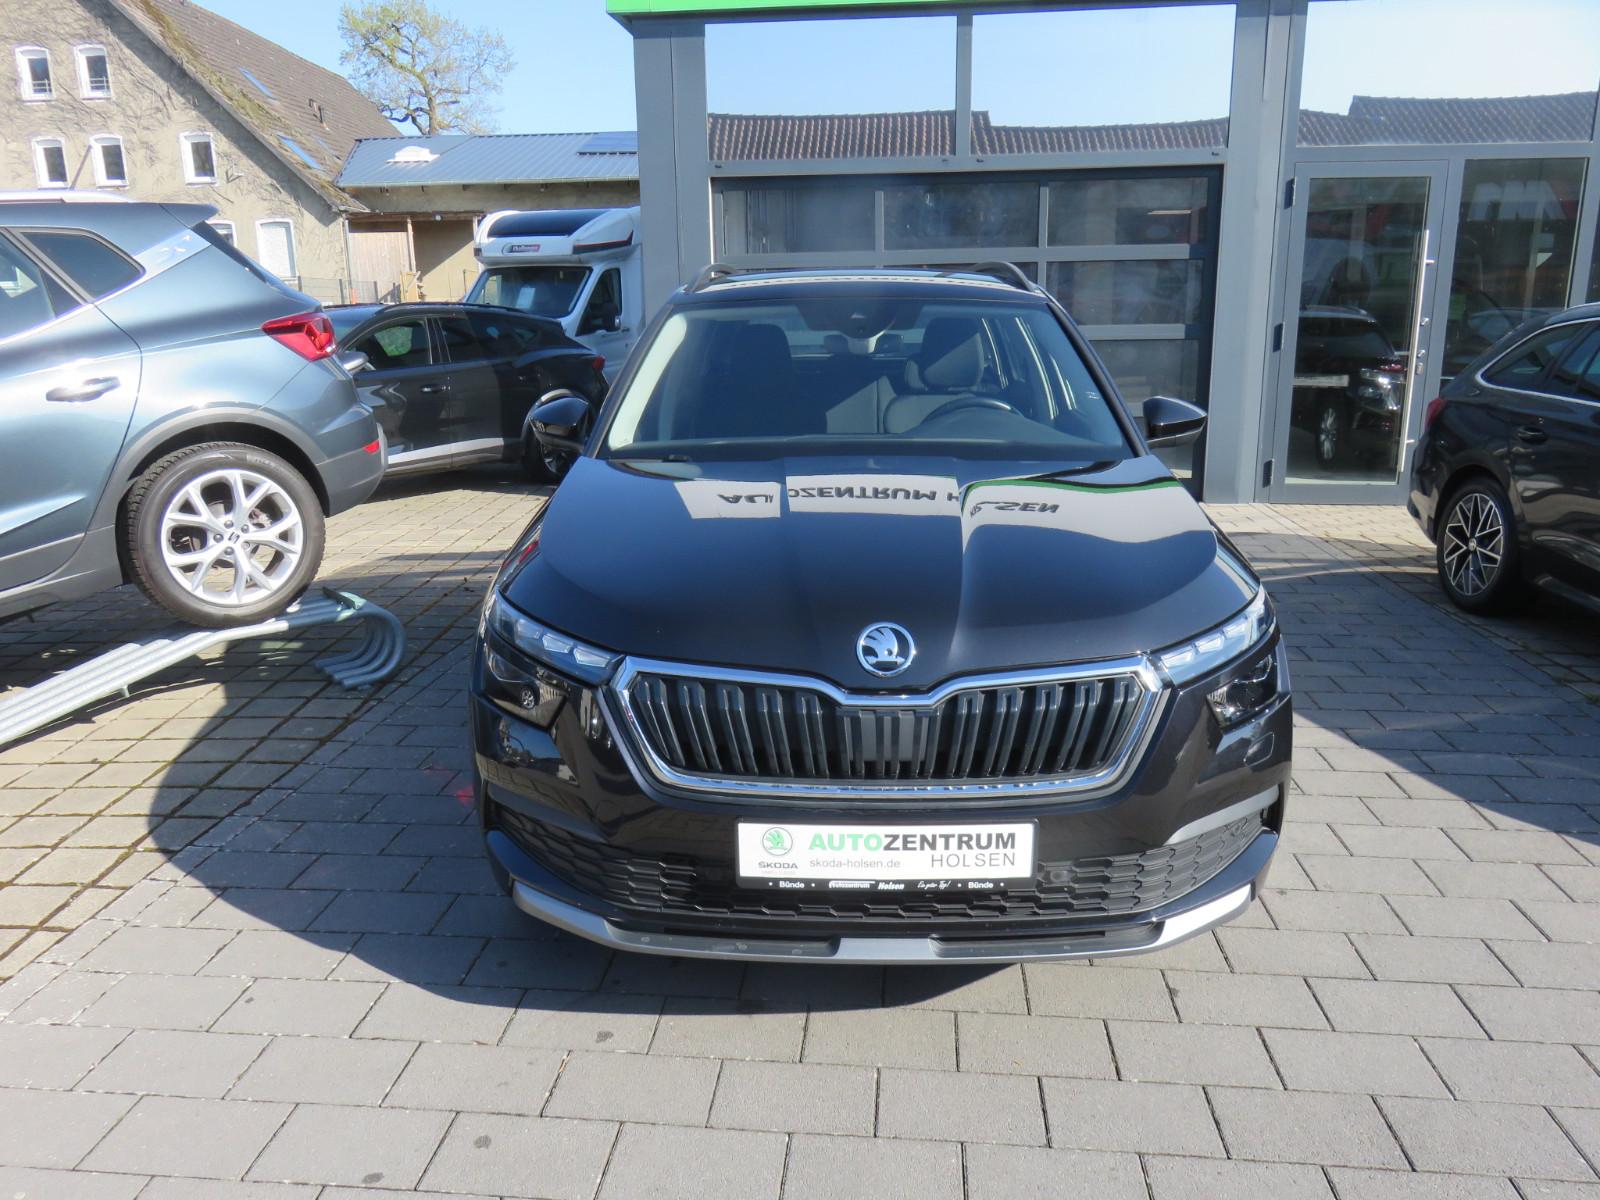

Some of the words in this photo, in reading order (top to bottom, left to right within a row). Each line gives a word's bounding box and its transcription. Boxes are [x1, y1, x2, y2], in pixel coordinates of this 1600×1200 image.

[809, 832, 1016, 851] AUTOZENTRUM
[809, 858, 900, 869] skoda-holsen.de
[931, 853, 1015, 868] HOLSEN
[779, 880, 805, 889] Bünde
[967, 881, 994, 889] Bünde
